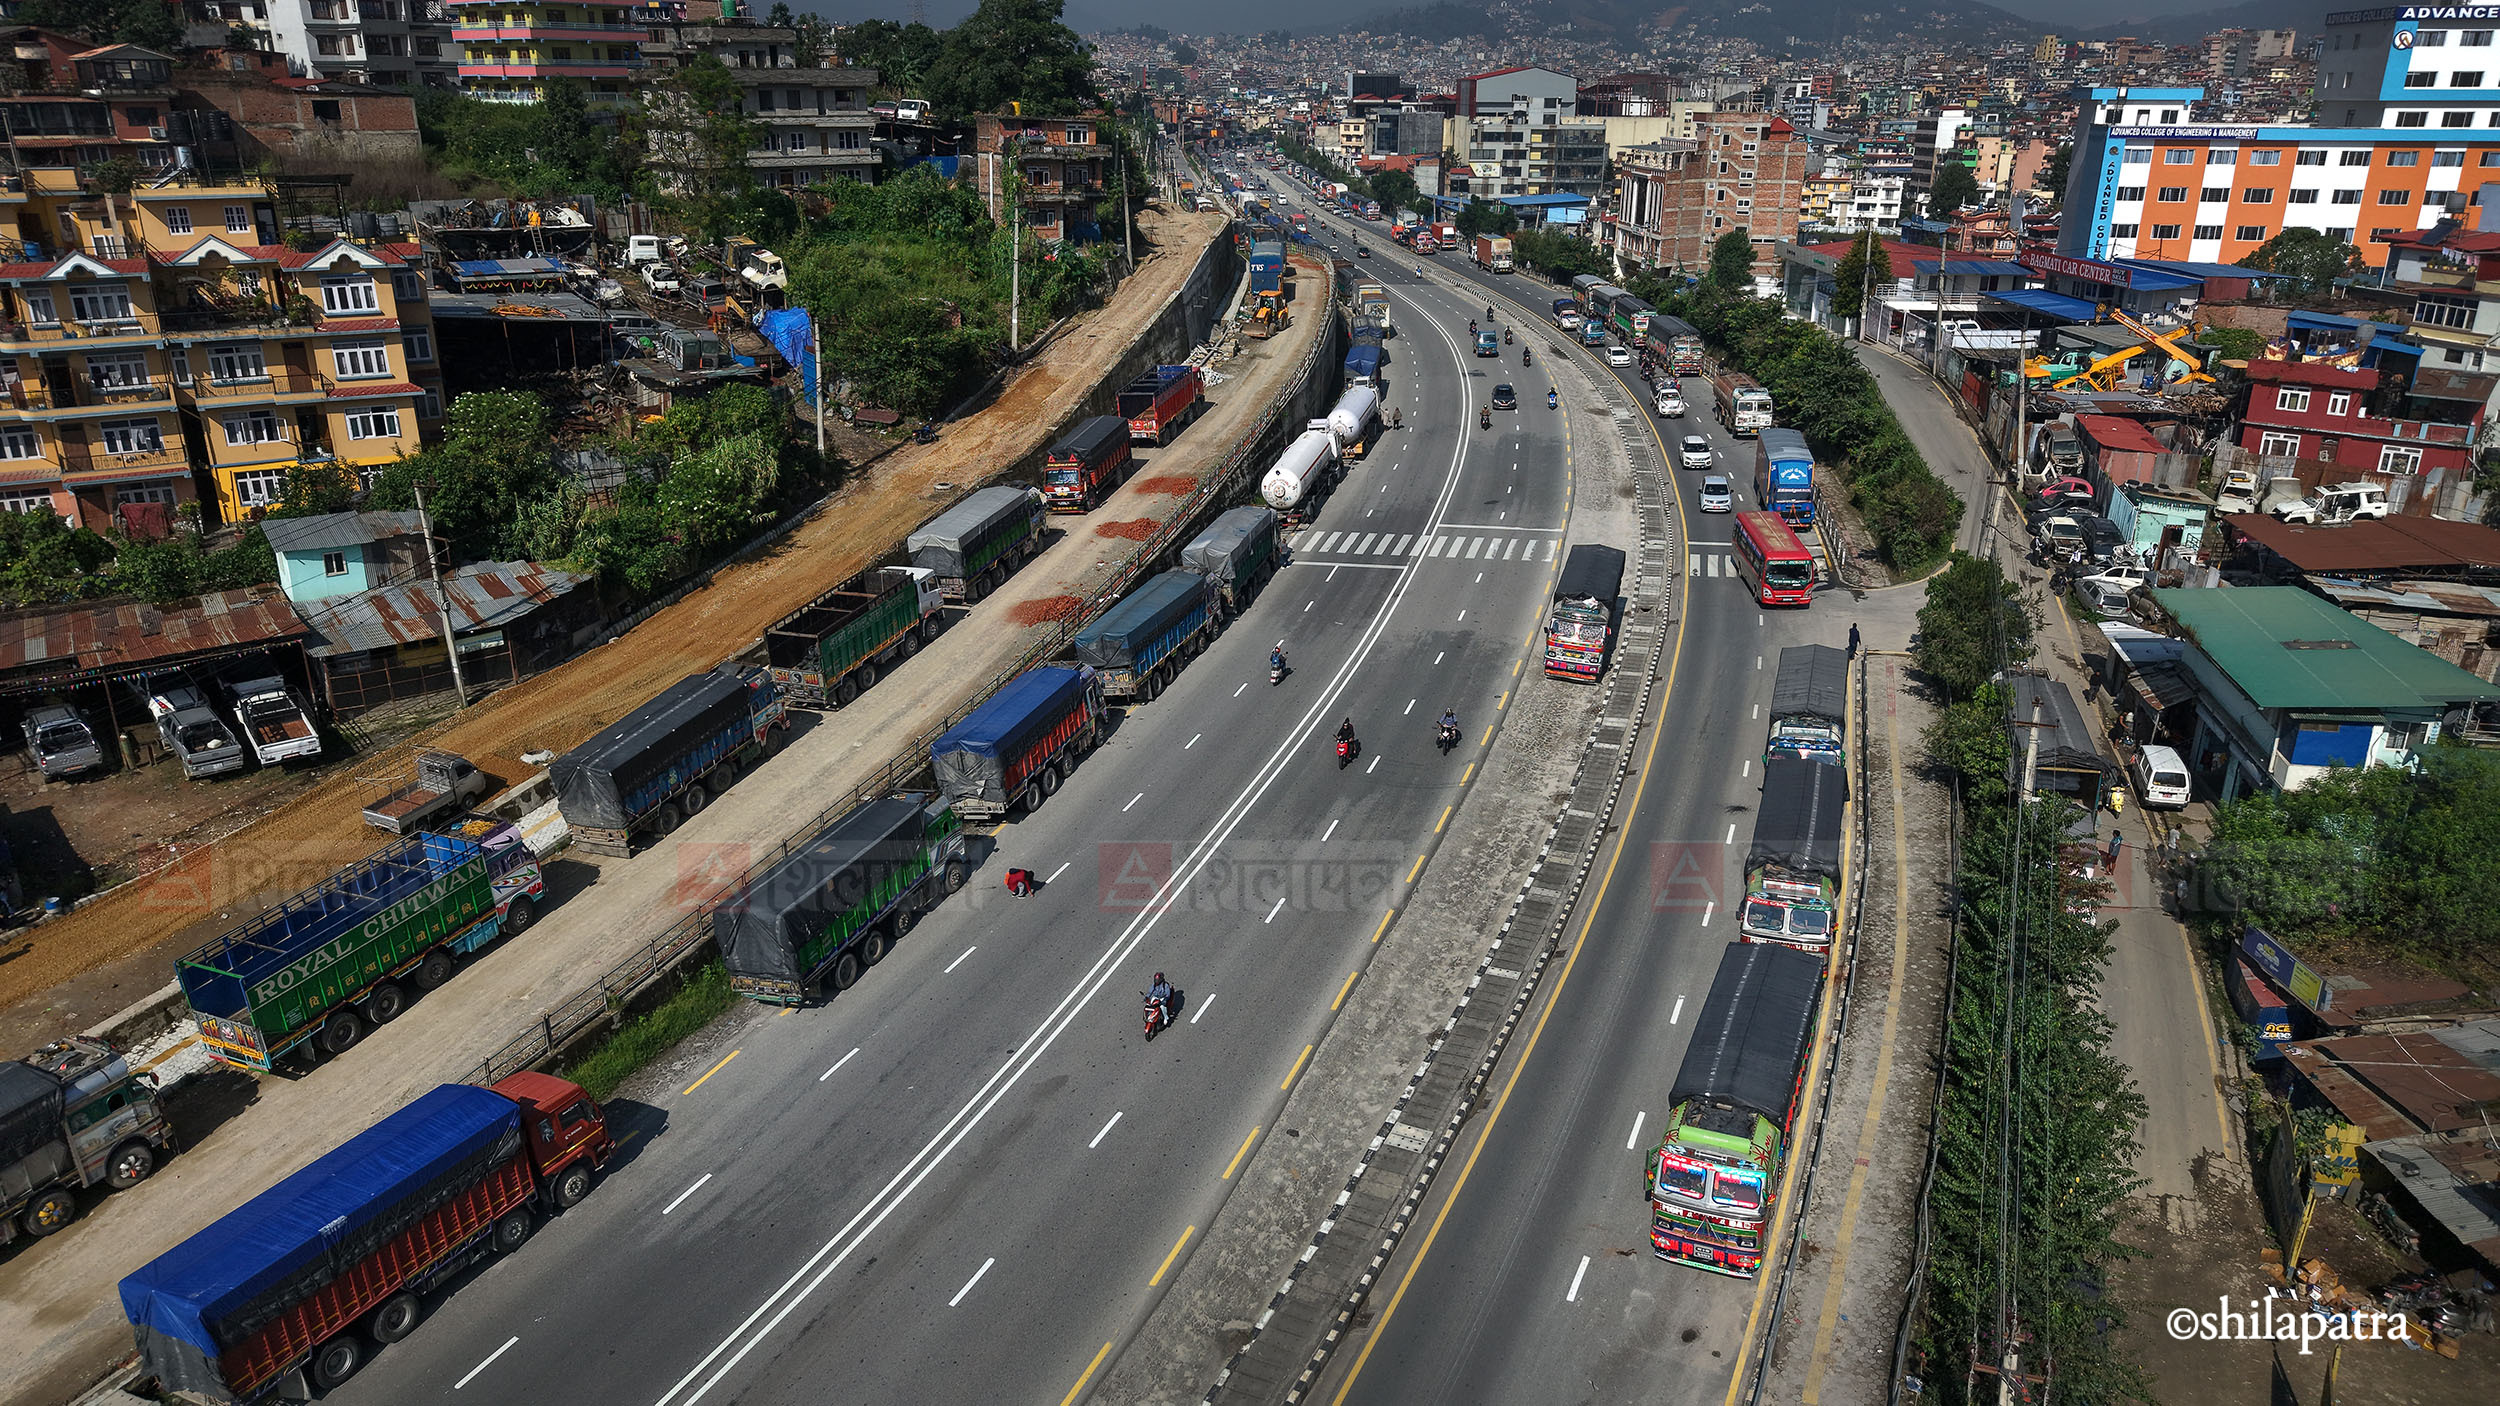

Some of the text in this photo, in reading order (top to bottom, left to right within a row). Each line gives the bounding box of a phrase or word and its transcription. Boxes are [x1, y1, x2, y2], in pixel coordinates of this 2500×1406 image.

[2402, 7, 2500, 19] ADVANCE
[2110, 127, 2140, 137] ADVANCED
[2140, 127, 2166, 137] COLLEGE
[2166, 128, 2174, 137] OF
[2174, 127, 2212, 137] ENGINEERING
[2212, 128, 2218, 137] &
[2218, 128, 2258, 138] MANAGEMENT
[2100, 161, 2116, 220] ADVANCED
[2030, 253, 2111, 283] BAGMATI CAR CENTER
[254, 940, 353, 1005] ROYAL
[363, 857, 485, 940] CHITWAN
